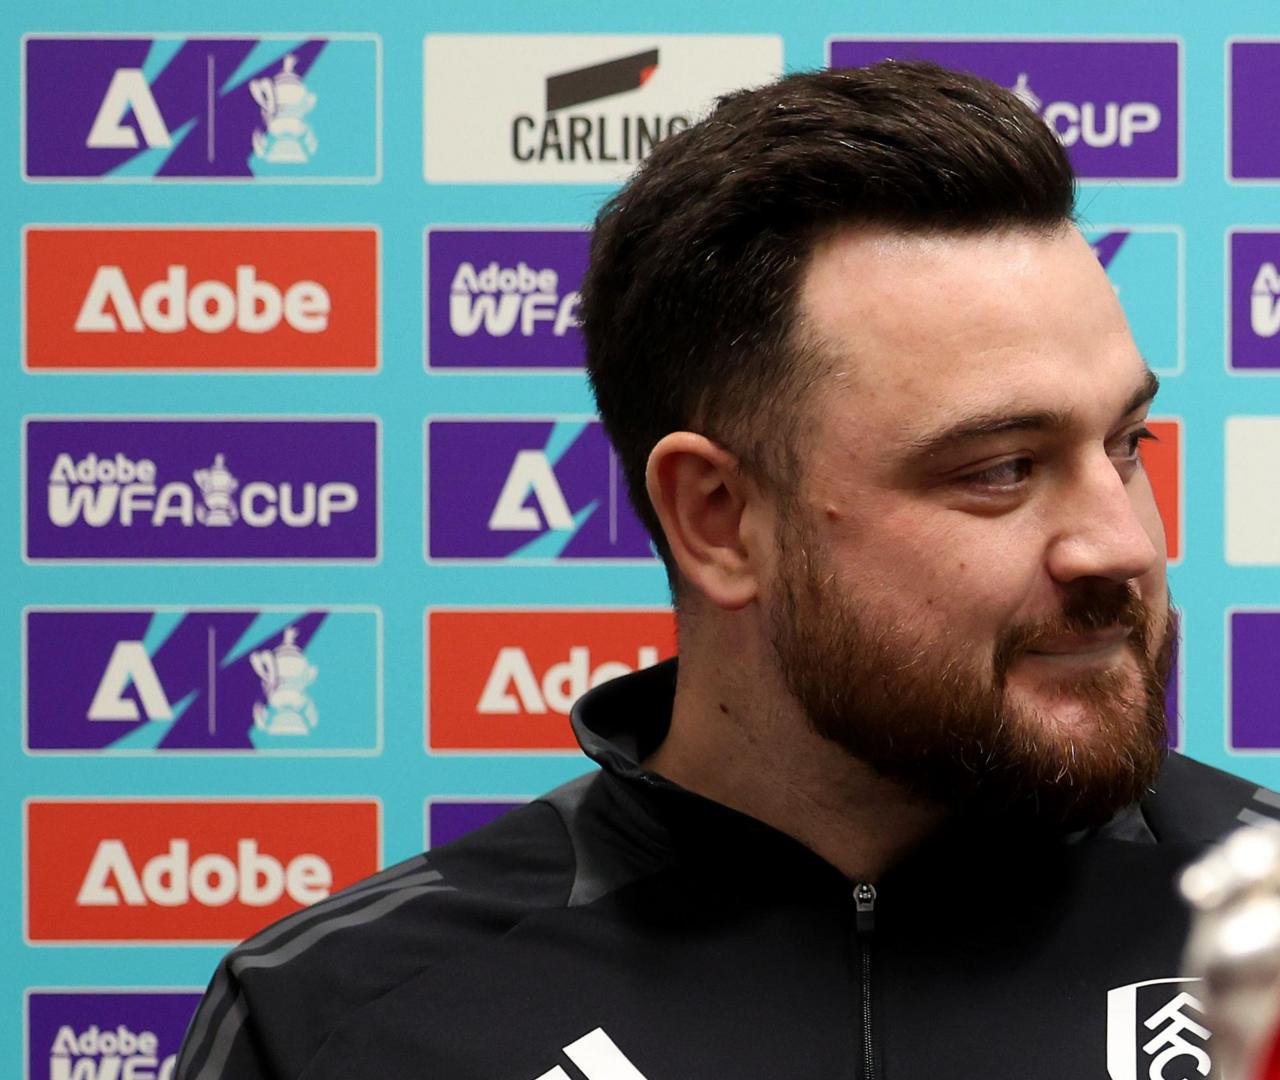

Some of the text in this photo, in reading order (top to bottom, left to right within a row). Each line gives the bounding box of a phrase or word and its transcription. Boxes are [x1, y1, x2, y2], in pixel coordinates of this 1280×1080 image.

[512, 115, 688, 162] CARLIN
[1044, 101, 1161, 148] CUP
[76, 266, 330, 332] Adobe
[452, 264, 557, 291] Adobe
[50, 454, 155, 483] Adobe
[241, 483, 357, 526] CUP
[78, 840, 332, 905] Adobe
[52, 1026, 157, 1054] Adobe
